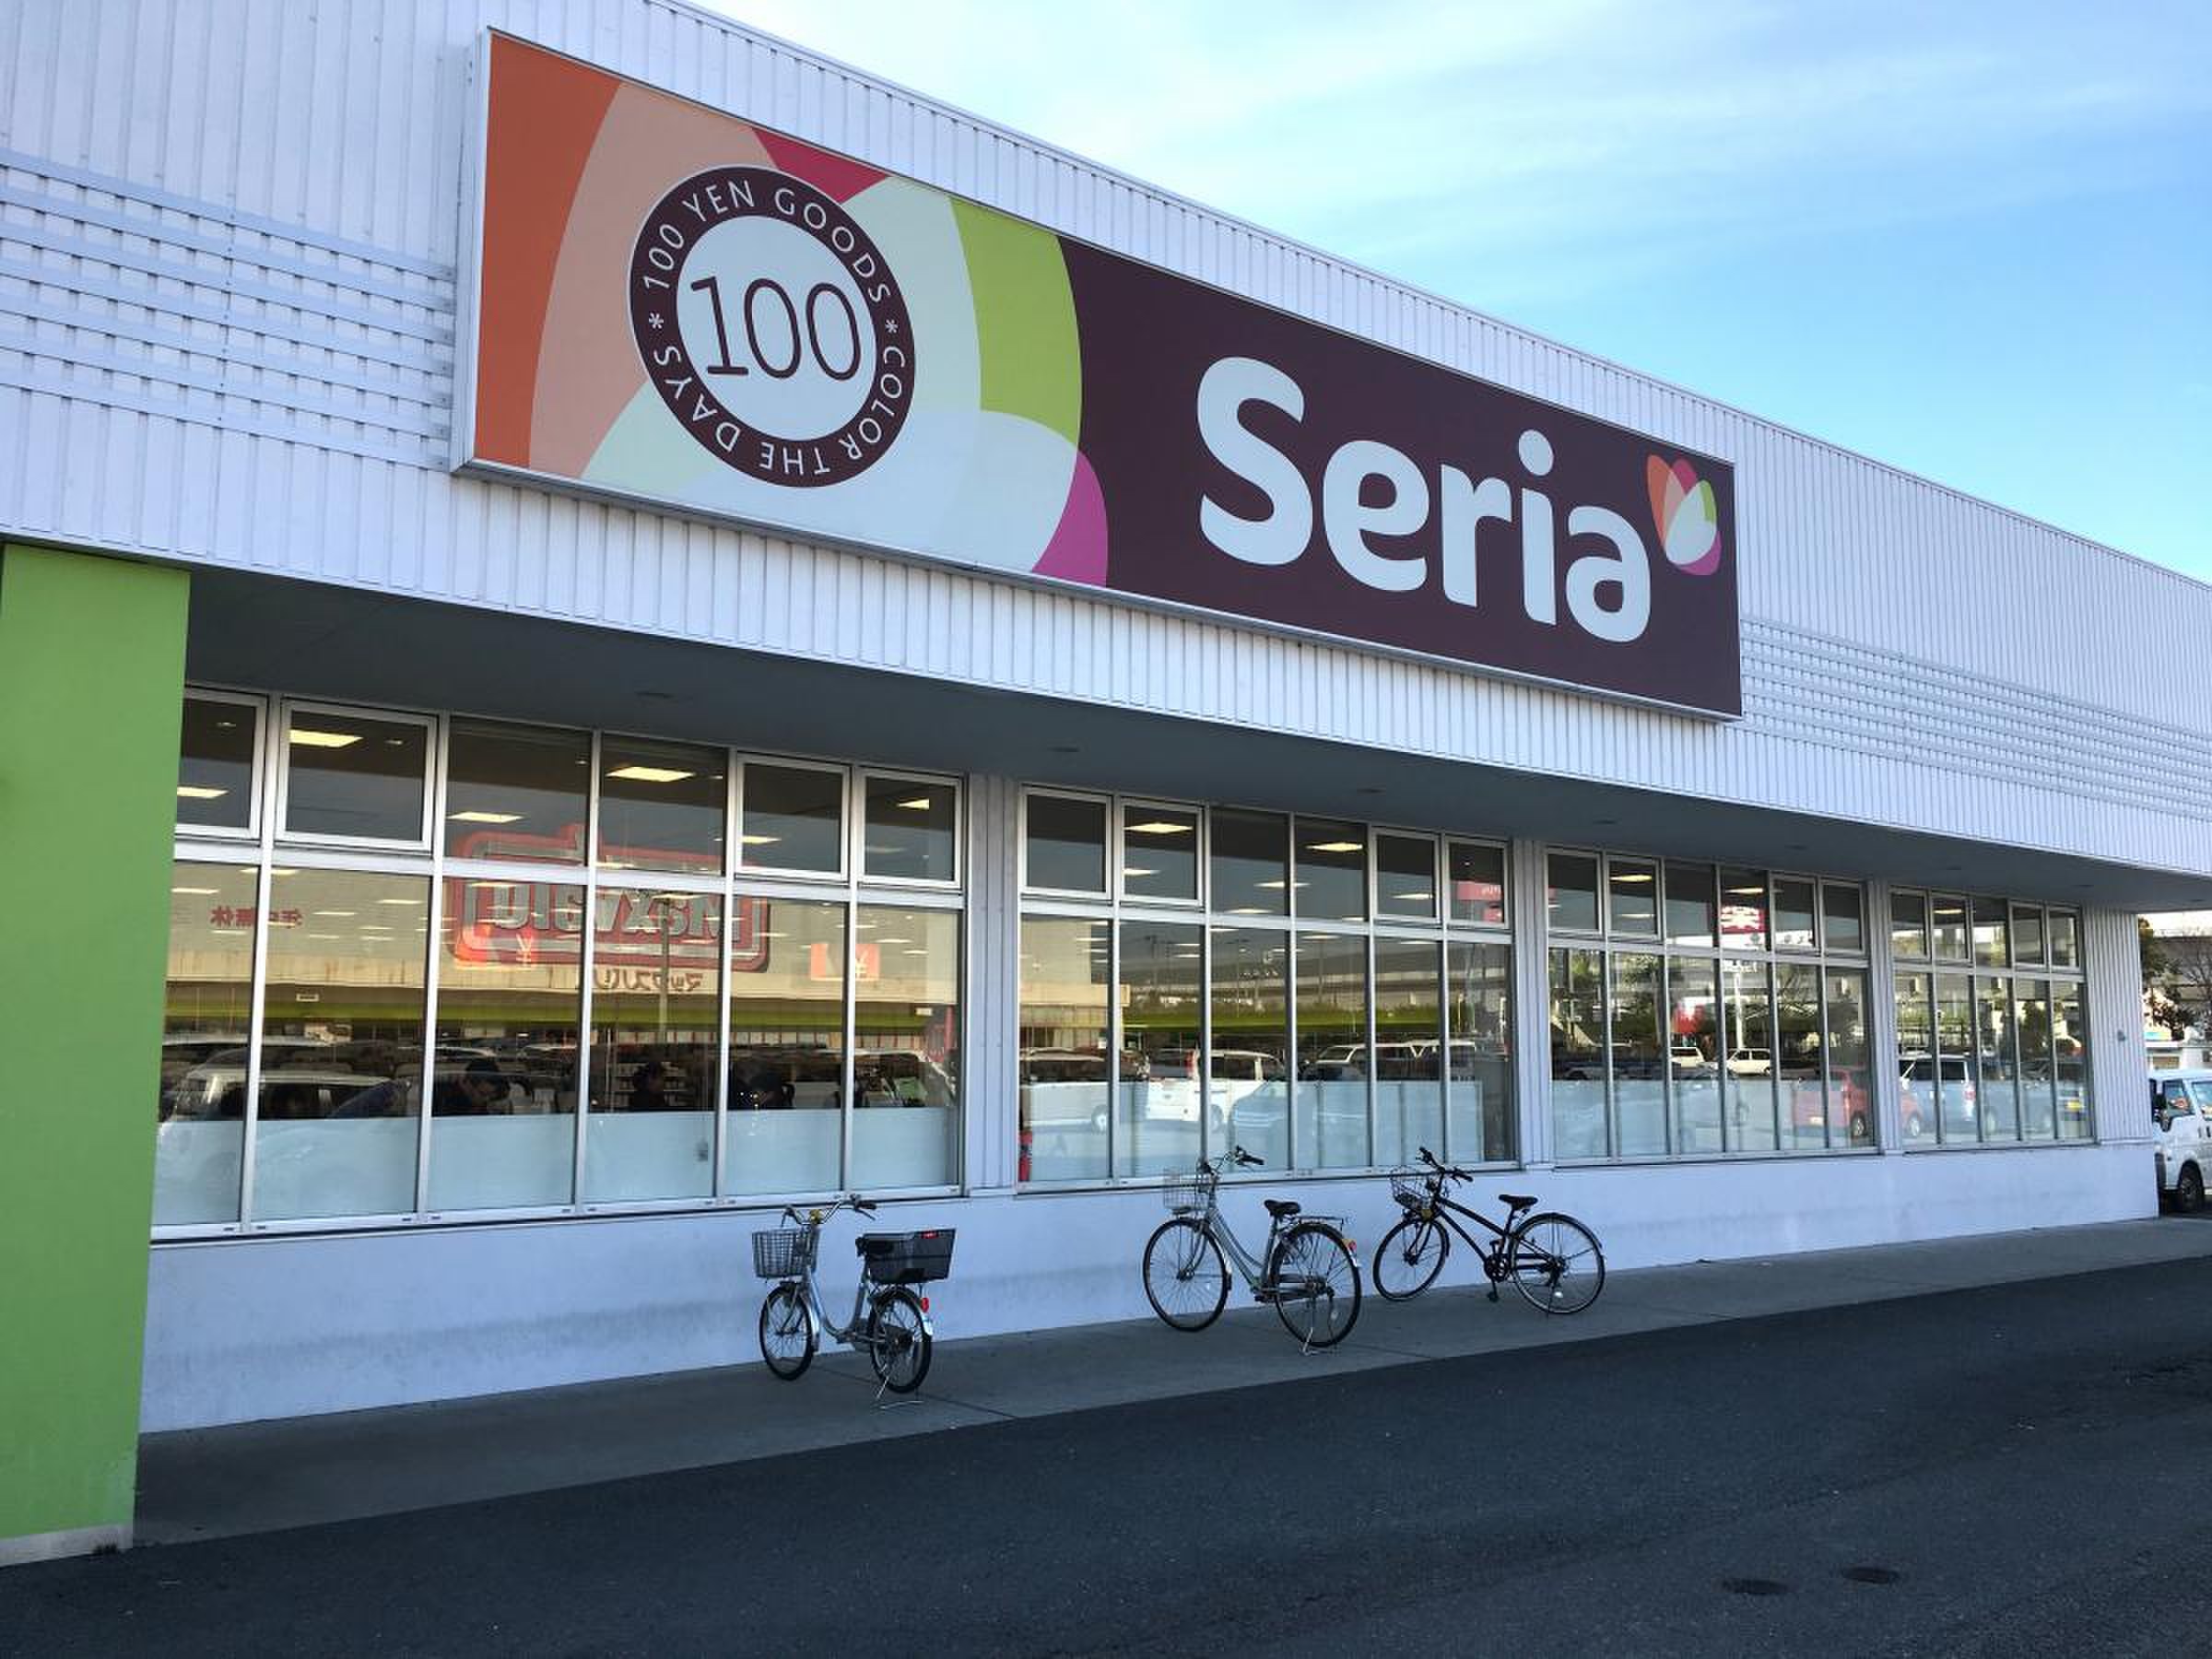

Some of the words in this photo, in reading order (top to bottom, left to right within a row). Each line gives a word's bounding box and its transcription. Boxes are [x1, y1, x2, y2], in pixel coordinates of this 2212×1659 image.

[643, 224, 685, 289] 100
[682, 180, 755, 222] YEN
[774, 187, 891, 302] GOODS
[691, 276, 862, 381] 100
[653, 345, 741, 453] DAYS
[838, 346, 906, 460] COLOR
[759, 441, 830, 476] THE
[1197, 357, 1652, 643] Seria
